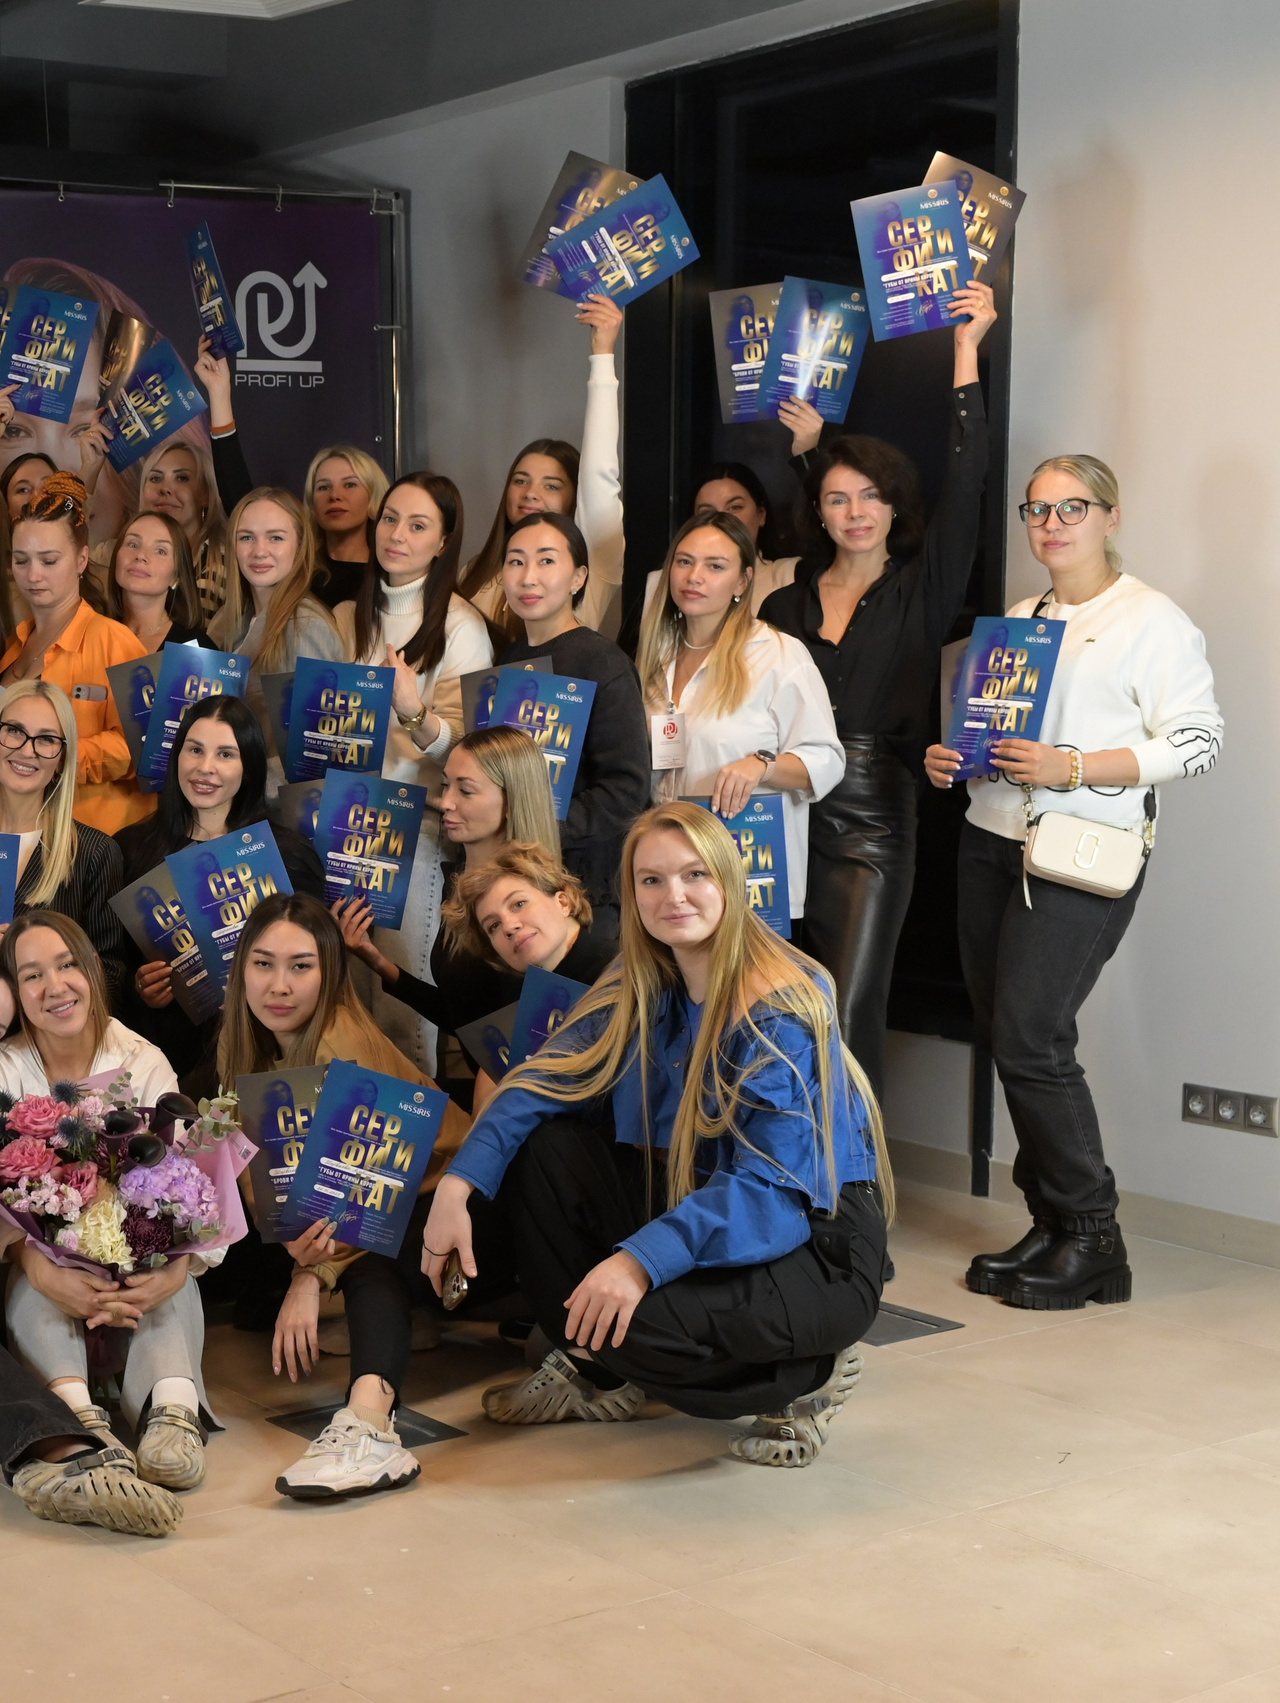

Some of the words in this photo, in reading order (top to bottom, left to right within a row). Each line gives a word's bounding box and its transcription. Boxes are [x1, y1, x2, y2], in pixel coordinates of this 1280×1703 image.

[632, 213, 666, 252] СЕР
[886, 214, 931, 246] СЕР
[914, 262, 959, 297] КАТ
[29, 314, 67, 340] СЕР
[235, 374, 292, 387] PROFI
[299, 375, 325, 388] UP
[987, 646, 1029, 673] СЕР
[320, 687, 362, 714] СЕР
[518, 699, 560, 727] СЕР
[386, 797, 415, 809] MISSIRIS
[347, 803, 392, 834] СЕР
[744, 814, 774, 823] MISSIRIS
[236, 842, 266, 857] MISSIRIS
[207, 862, 253, 900] СЕР
[353, 861, 400, 893] КАТ
[348, 1103, 403, 1143] СЕР
[397, 1101, 432, 1118] MISSIRIS
[347, 1172, 404, 1215] КАТ
